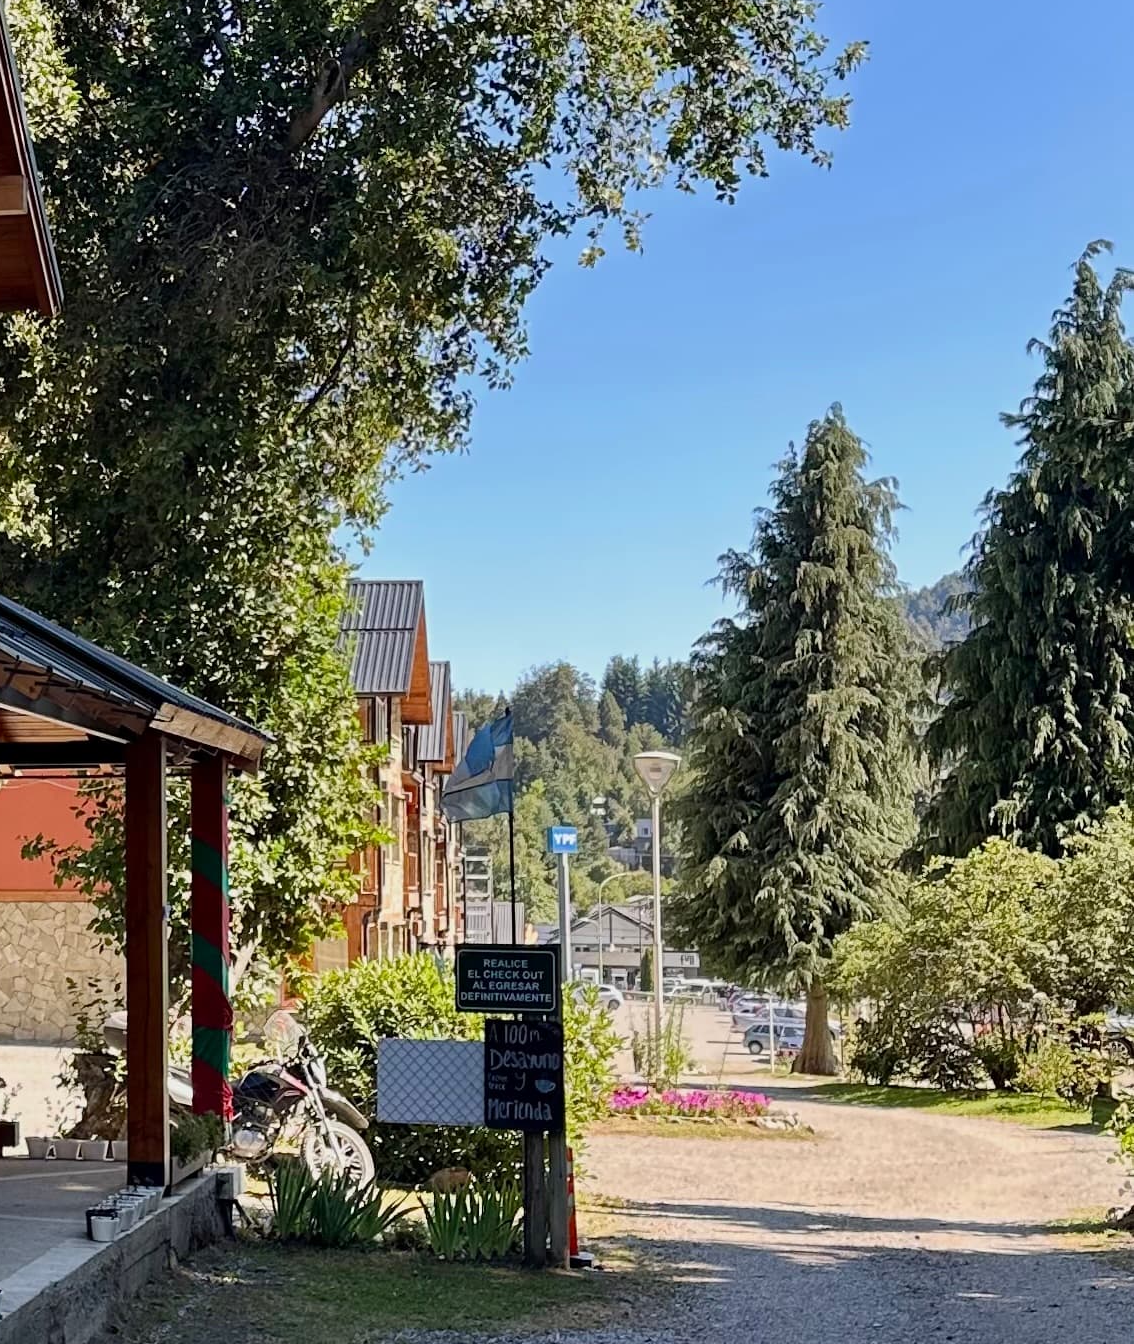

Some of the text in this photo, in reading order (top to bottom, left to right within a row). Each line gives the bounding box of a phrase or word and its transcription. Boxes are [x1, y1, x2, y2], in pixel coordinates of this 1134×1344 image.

[554, 834, 576, 845] YPF
[483, 959, 528, 968] REALICE
[468, 970, 544, 979] EL CHECK OUT
[472, 981, 539, 991] AL EGRESAR
[461, 992, 552, 1002] DEFINITIVAMENTE
[490, 1049, 560, 1070] Desayuno
[488, 1098, 553, 1120] Merienda
